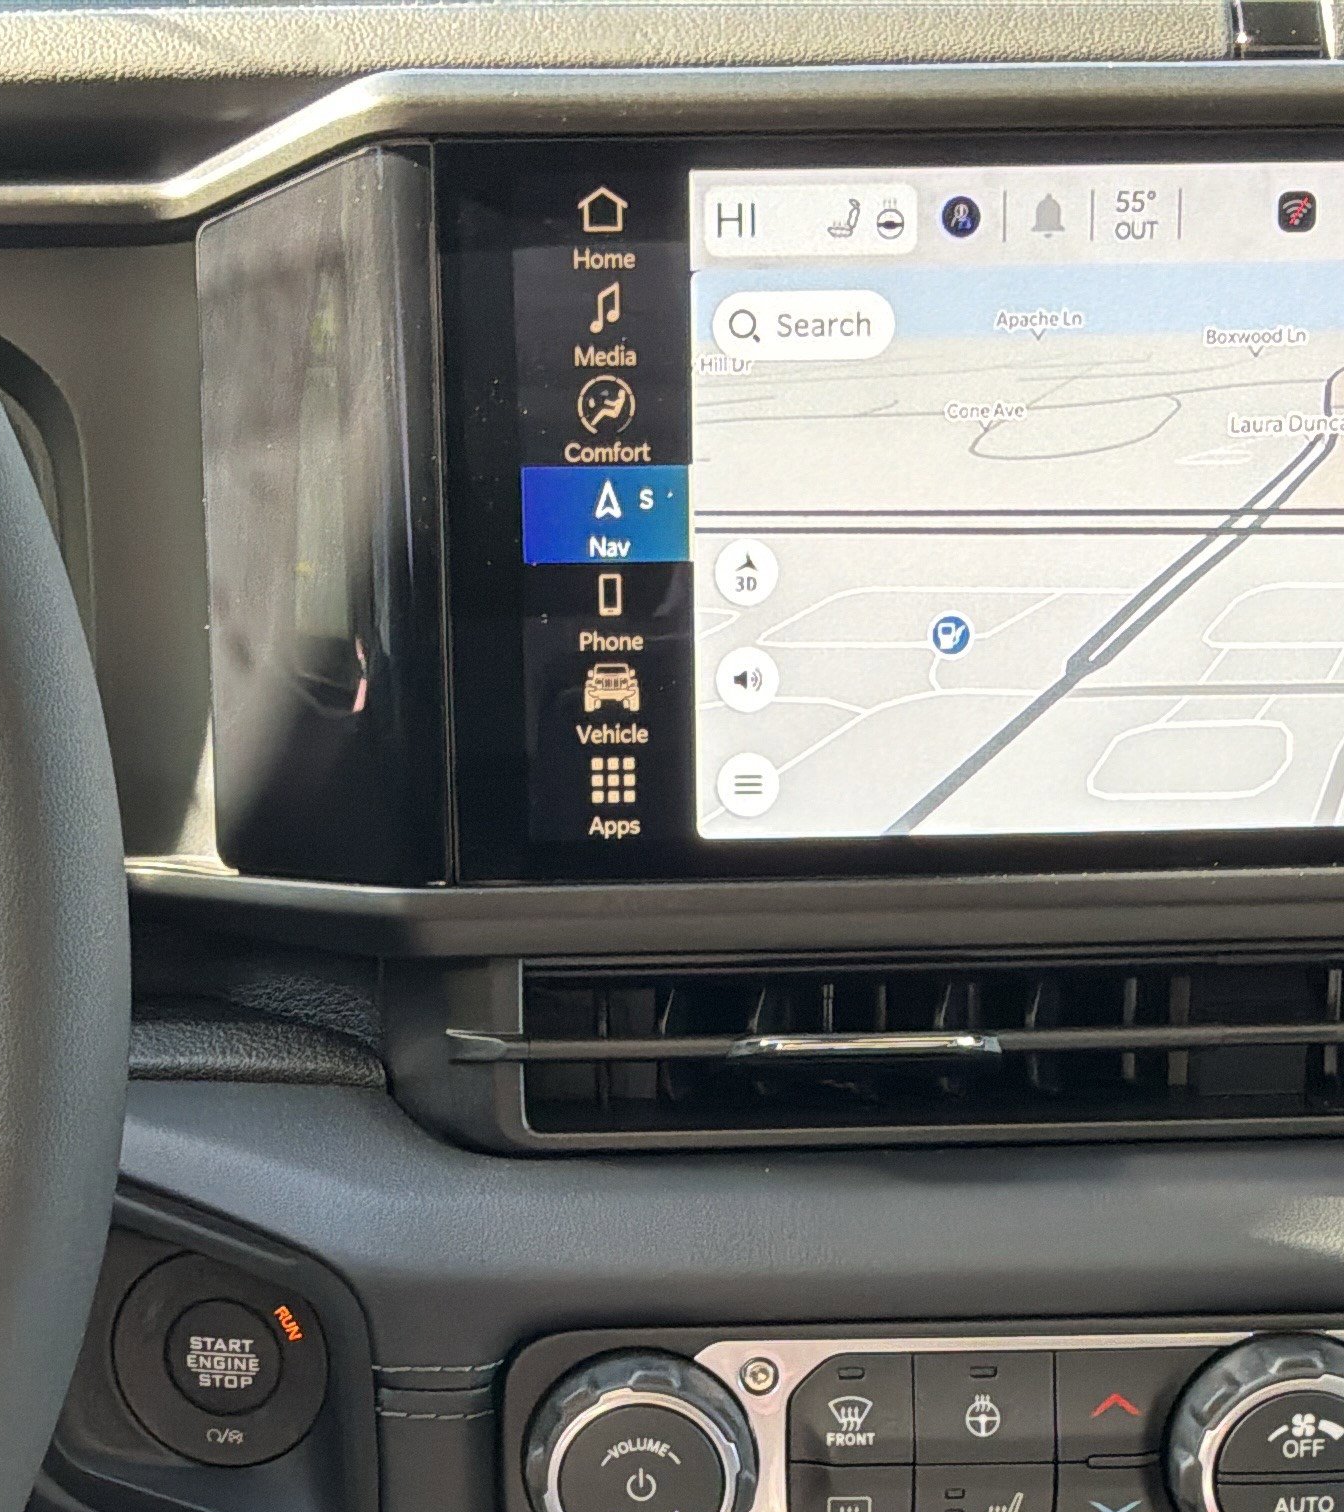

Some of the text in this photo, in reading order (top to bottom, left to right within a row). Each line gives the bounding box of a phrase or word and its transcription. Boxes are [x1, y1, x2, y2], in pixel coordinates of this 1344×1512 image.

[1116, 190, 1156, 214] 55°
[716, 202, 757, 238] HI
[1115, 222, 1158, 240] OUT
[573, 248, 636, 271] Home
[777, 311, 871, 338] Search
[996, 309, 1082, 330] Apache Ln
[1206, 329, 1306, 344] Boxwood Ln
[574, 346, 637, 369] Media
[700, 358, 728, 372] Hill
[947, 403, 1025, 420] Cone Ave
[1231, 414, 1284, 433] Laura
[564, 441, 651, 463] Comfort
[639, 488, 654, 510] S
[589, 535, 631, 558] Nav
[736, 576, 756, 593] 3D
[579, 633, 644, 651] Phone
[576, 725, 649, 745] Vehicle
[589, 817, 641, 839] Apps
[274, 1305, 303, 1341] RUN
[189, 1336, 254, 1353] START
[186, 1354, 260, 1372] ENGINE
[198, 1373, 253, 1389] STOP
[611, 1438, 670, 1459] VOLUME
[826, 1432, 876, 1446] FRONT
[1282, 1438, 1326, 1459] OFF
